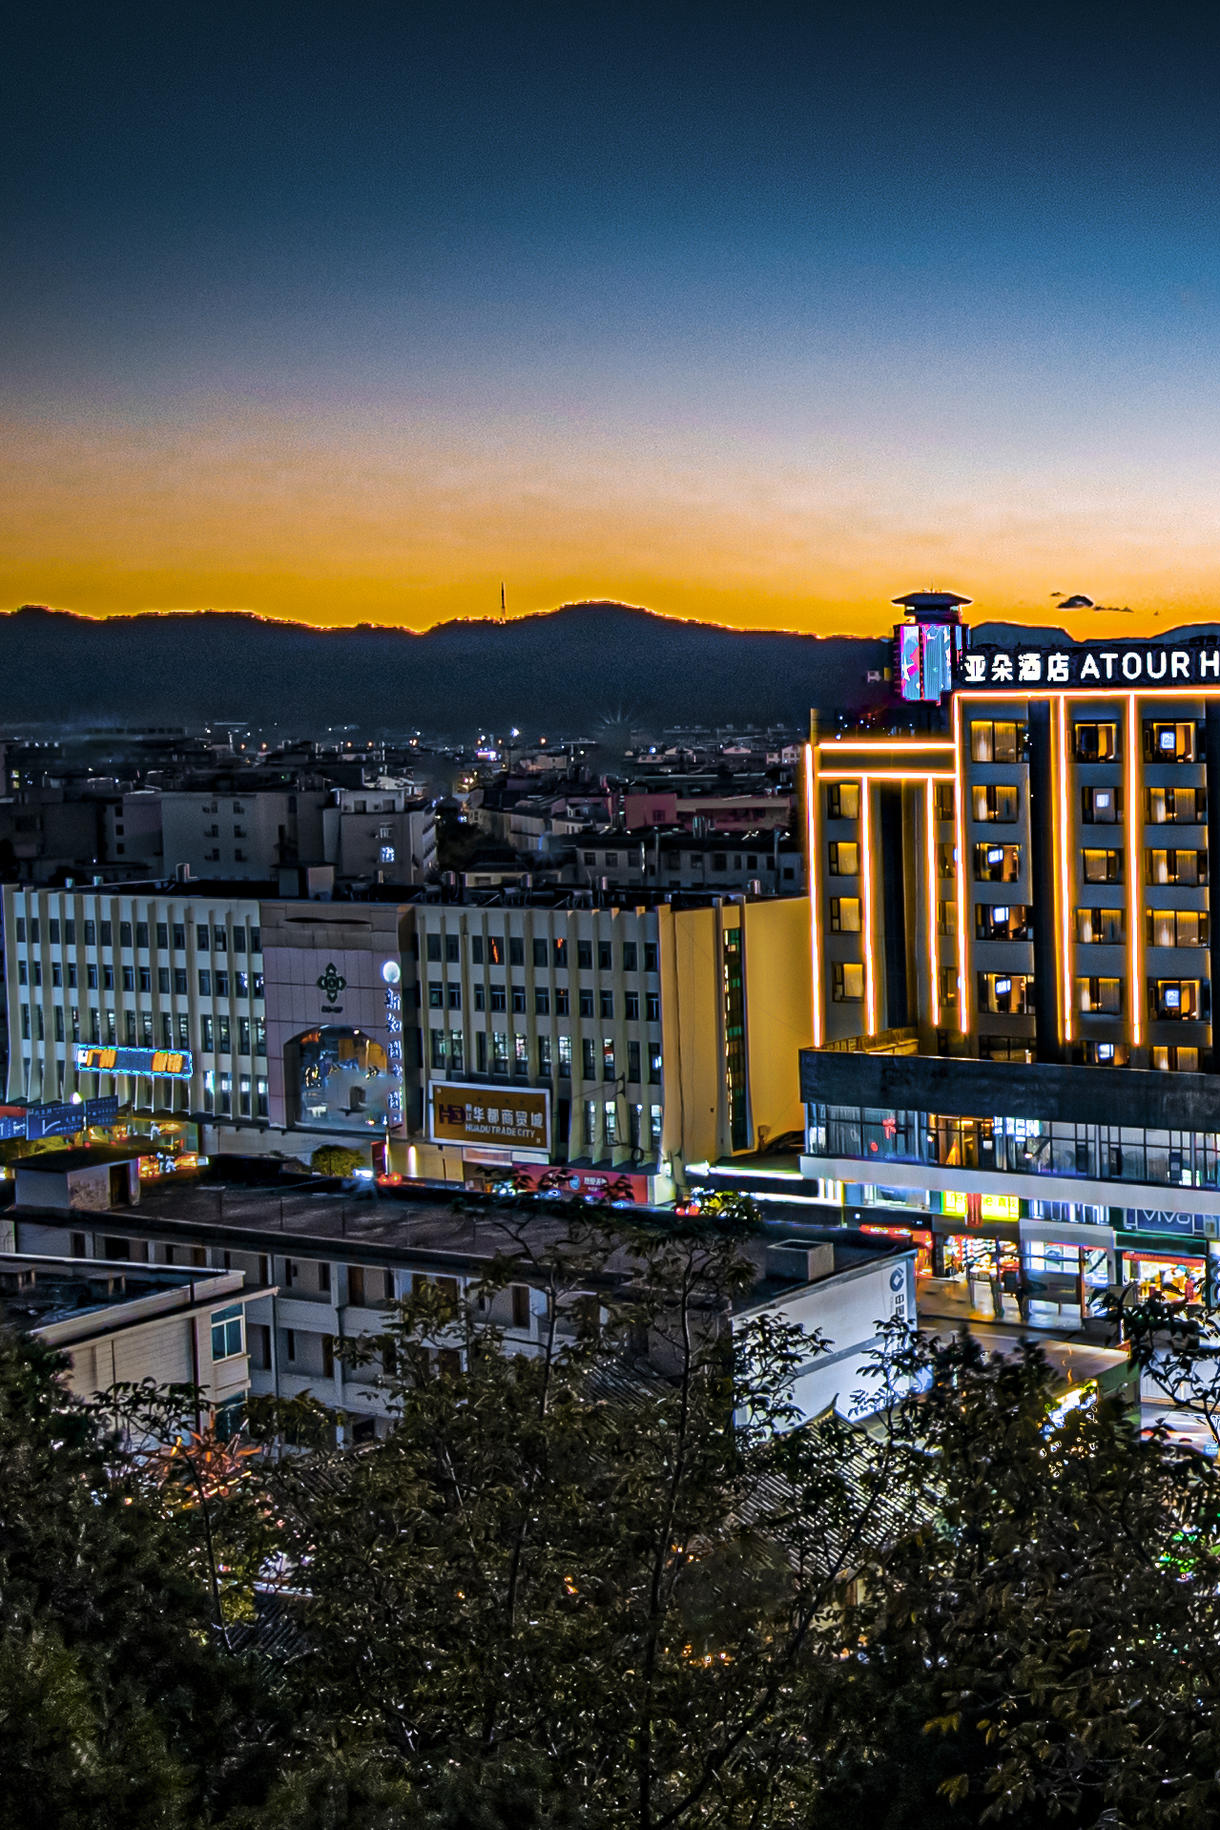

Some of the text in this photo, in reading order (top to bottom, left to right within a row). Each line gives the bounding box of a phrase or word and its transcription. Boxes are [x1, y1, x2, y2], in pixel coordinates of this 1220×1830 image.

[964, 652, 1070, 682] 亚朵酒店
[1080, 651, 1190, 680] ATOUR
[491, 1126, 516, 1137] TRADE
[517, 1128, 536, 1138] CITY
